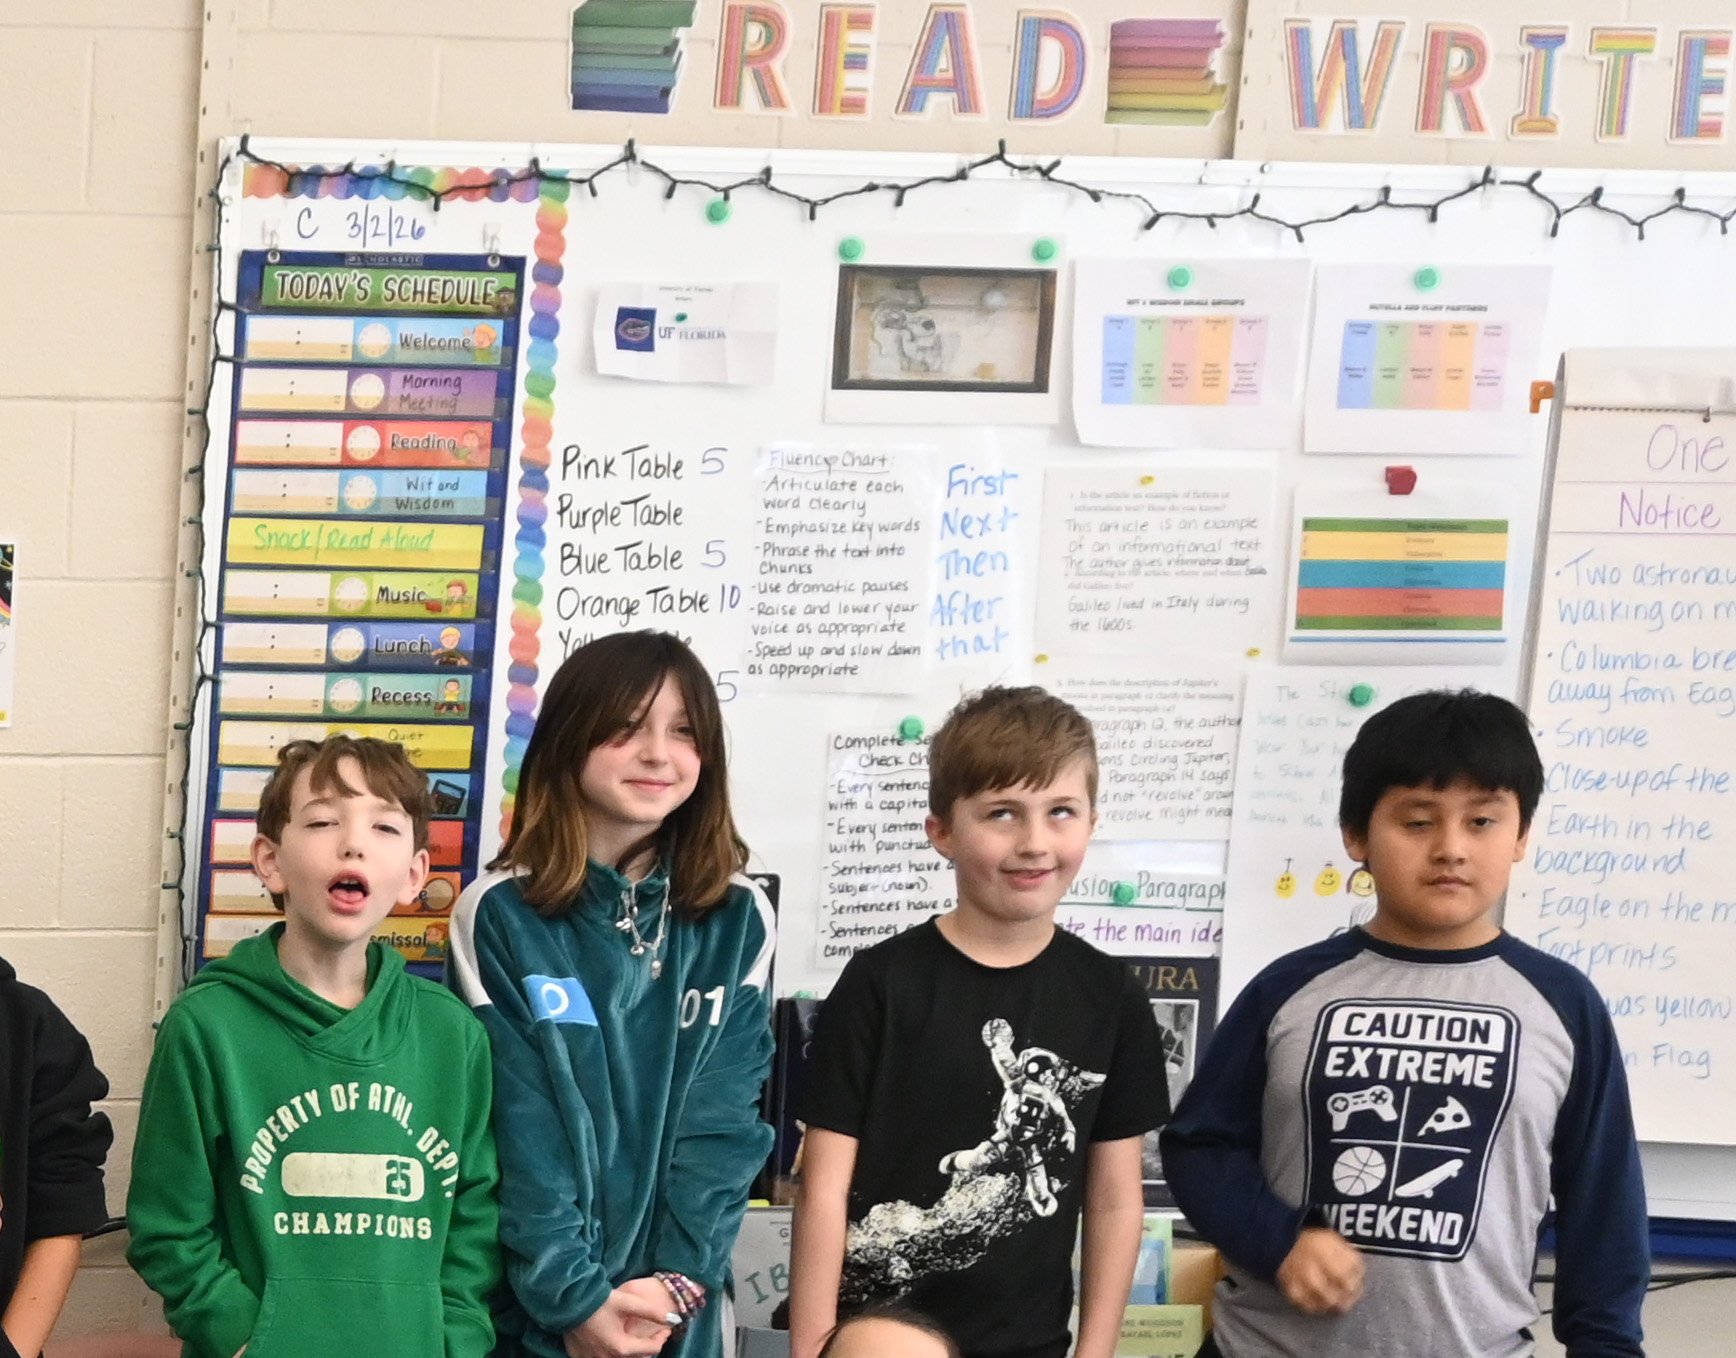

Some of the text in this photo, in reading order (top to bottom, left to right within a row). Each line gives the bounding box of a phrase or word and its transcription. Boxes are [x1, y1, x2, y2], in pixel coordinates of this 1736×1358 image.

[713, 1, 1092, 124] READ
[1283, 17, 1734, 142] WRITE
[297, 204, 425, 248] C 3/2/26
[276, 270, 497, 306] TODAY'S SCHEDULE
[399, 332, 471, 351] Welcome
[402, 374, 462, 395] Morning
[399, 394, 458, 413] Meeting
[391, 433, 457, 451] Reading
[1647, 424, 1729, 473] One
[561, 444, 728, 481] Pink Table 5
[407, 476, 460, 492] Wit and
[947, 463, 1018, 498] First
[395, 497, 455, 511] Wisdom
[556, 493, 683, 534] Purple Table
[1619, 488, 1721, 528] Notice
[940, 505, 1019, 540] Next
[559, 540, 726, 576] Blue Table 5
[939, 548, 1009, 580] Then
[1565, 549, 1621, 586] Two
[377, 585, 428, 604] Music
[556, 584, 741, 627] Orange Table 10
[931, 590, 1004, 626] After
[1670, 601, 1703, 621] on
[375, 636, 432, 655] Lunch
[752, 621, 906, 636] voice as appropriate
[936, 625, 1009, 660] that
[1560, 640, 1682, 672] Columbia
[371, 687, 433, 705] Recess
[717, 671, 740, 702] 5
[1548, 677, 1675, 713] away from
[1556, 718, 1649, 748] Smoke
[1547, 804, 1713, 840] Earth in the
[1533, 847, 1687, 884] background
[1539, 887, 1701, 929] Eagle on the
[1343, 1012, 1491, 1044] CAUTION
[1324, 1046, 1497, 1090] EXTREME
[239, 1081, 459, 1199] PROPERTY OF ATHL. DEPT.
[385, 1159, 412, 1197] 25
[273, 1211, 433, 1241] CHAMPIONS
